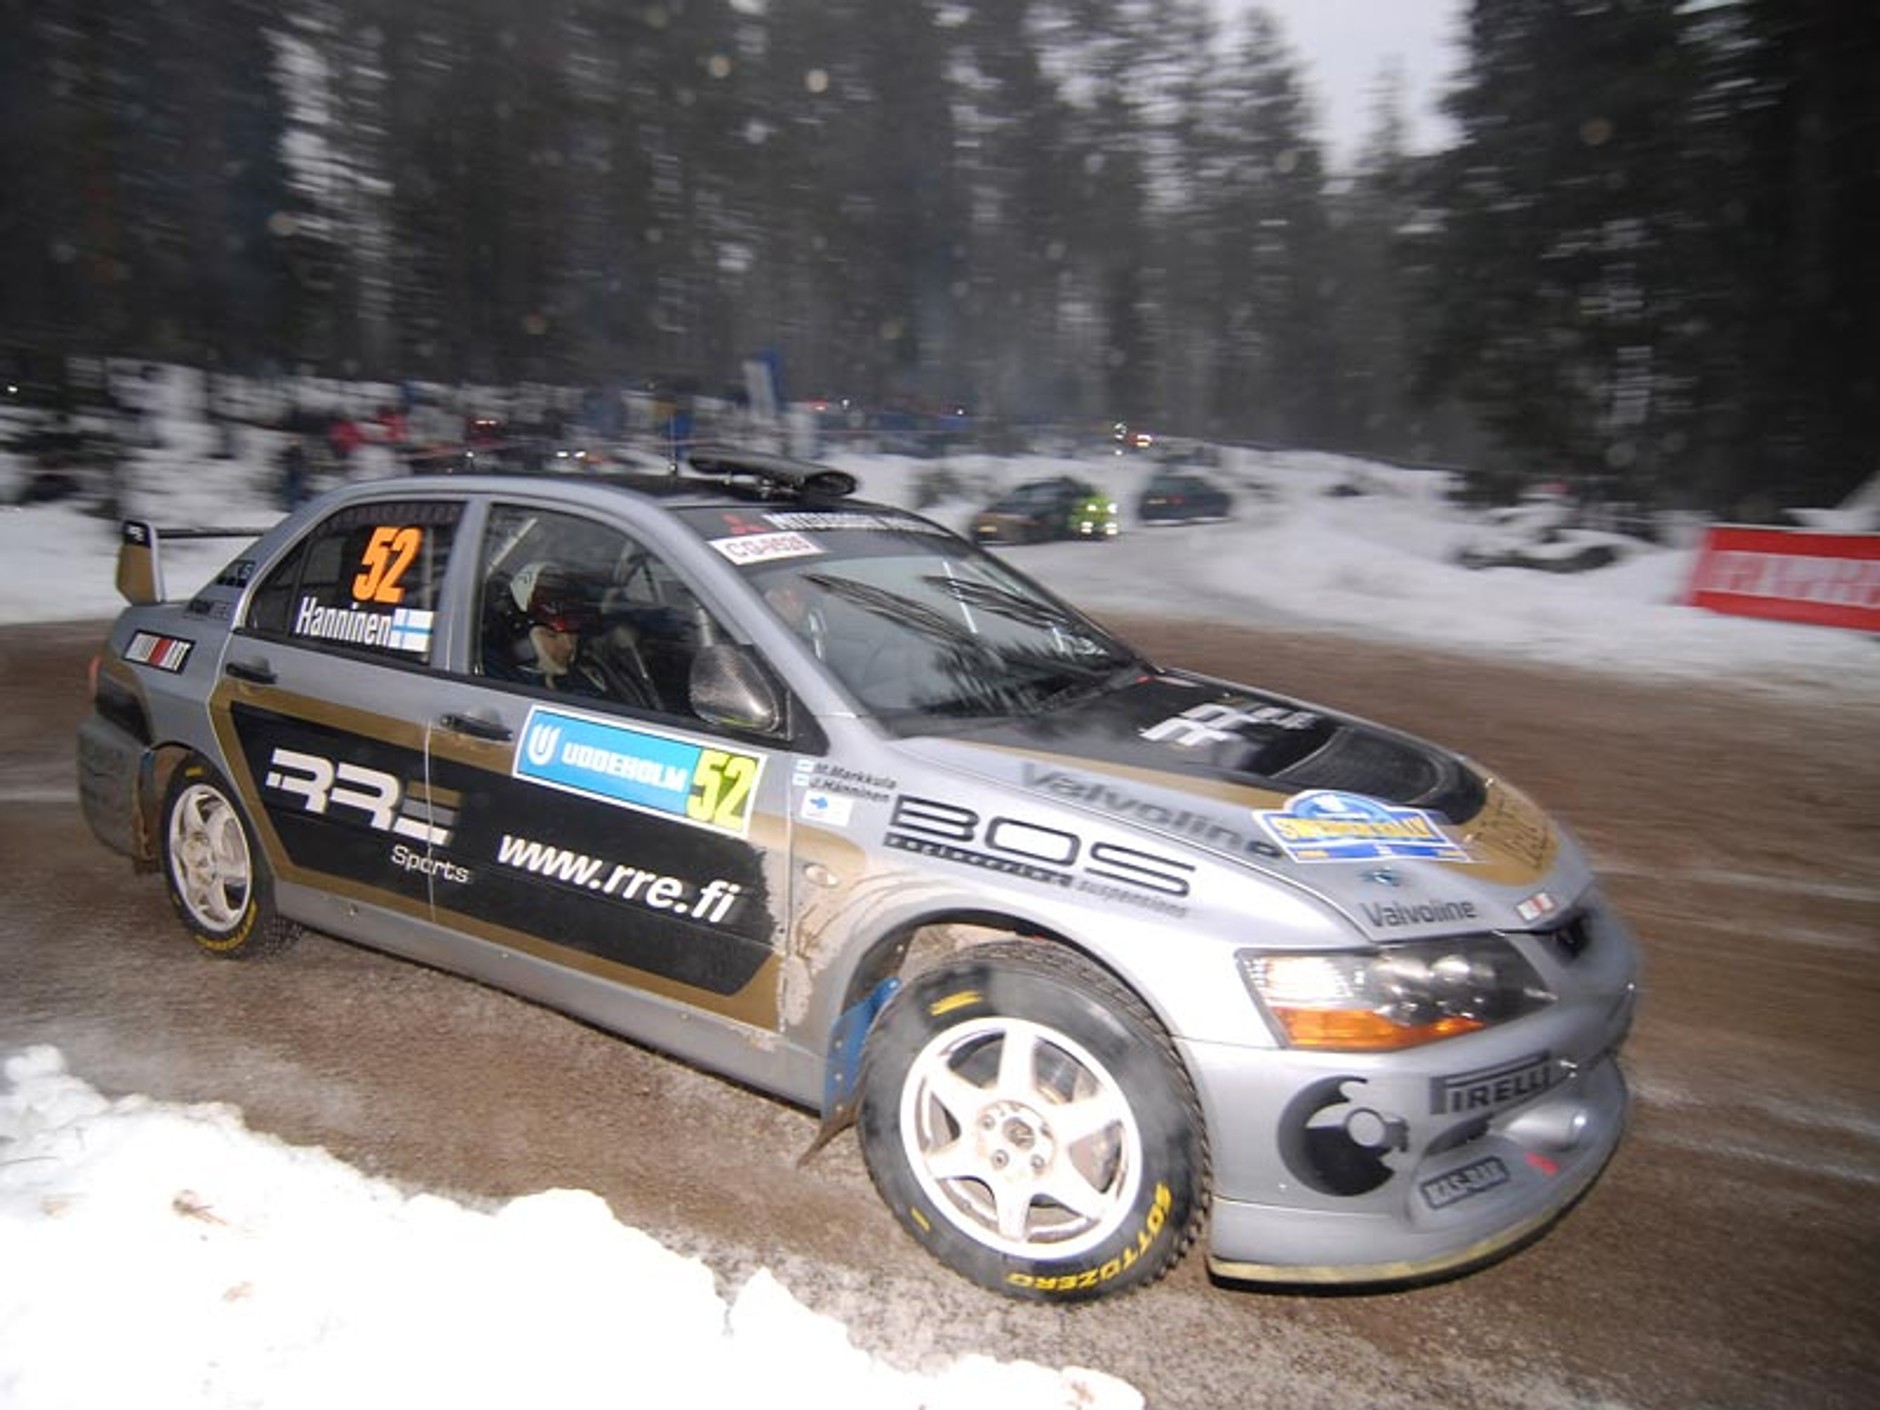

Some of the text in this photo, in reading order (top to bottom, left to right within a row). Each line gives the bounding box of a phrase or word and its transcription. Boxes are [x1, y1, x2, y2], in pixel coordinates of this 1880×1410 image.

[352, 525, 422, 604] 52
[295, 597, 392, 646] Hanninen
[266, 749, 462, 846] RRE
[561, 742, 688, 792] UDDEHOLM
[687, 749, 758, 832] 52
[890, 795, 1196, 897] BOS
[1021, 763, 1284, 857] Valvoline
[390, 844, 470, 884] Sports
[497, 834, 741, 923] www.rre.fi
[1360, 901, 1477, 928] Valvoline
[1429, 1050, 1551, 1115] PIRELLI
[1005, 1180, 1172, 1291] SOTTOZERO
